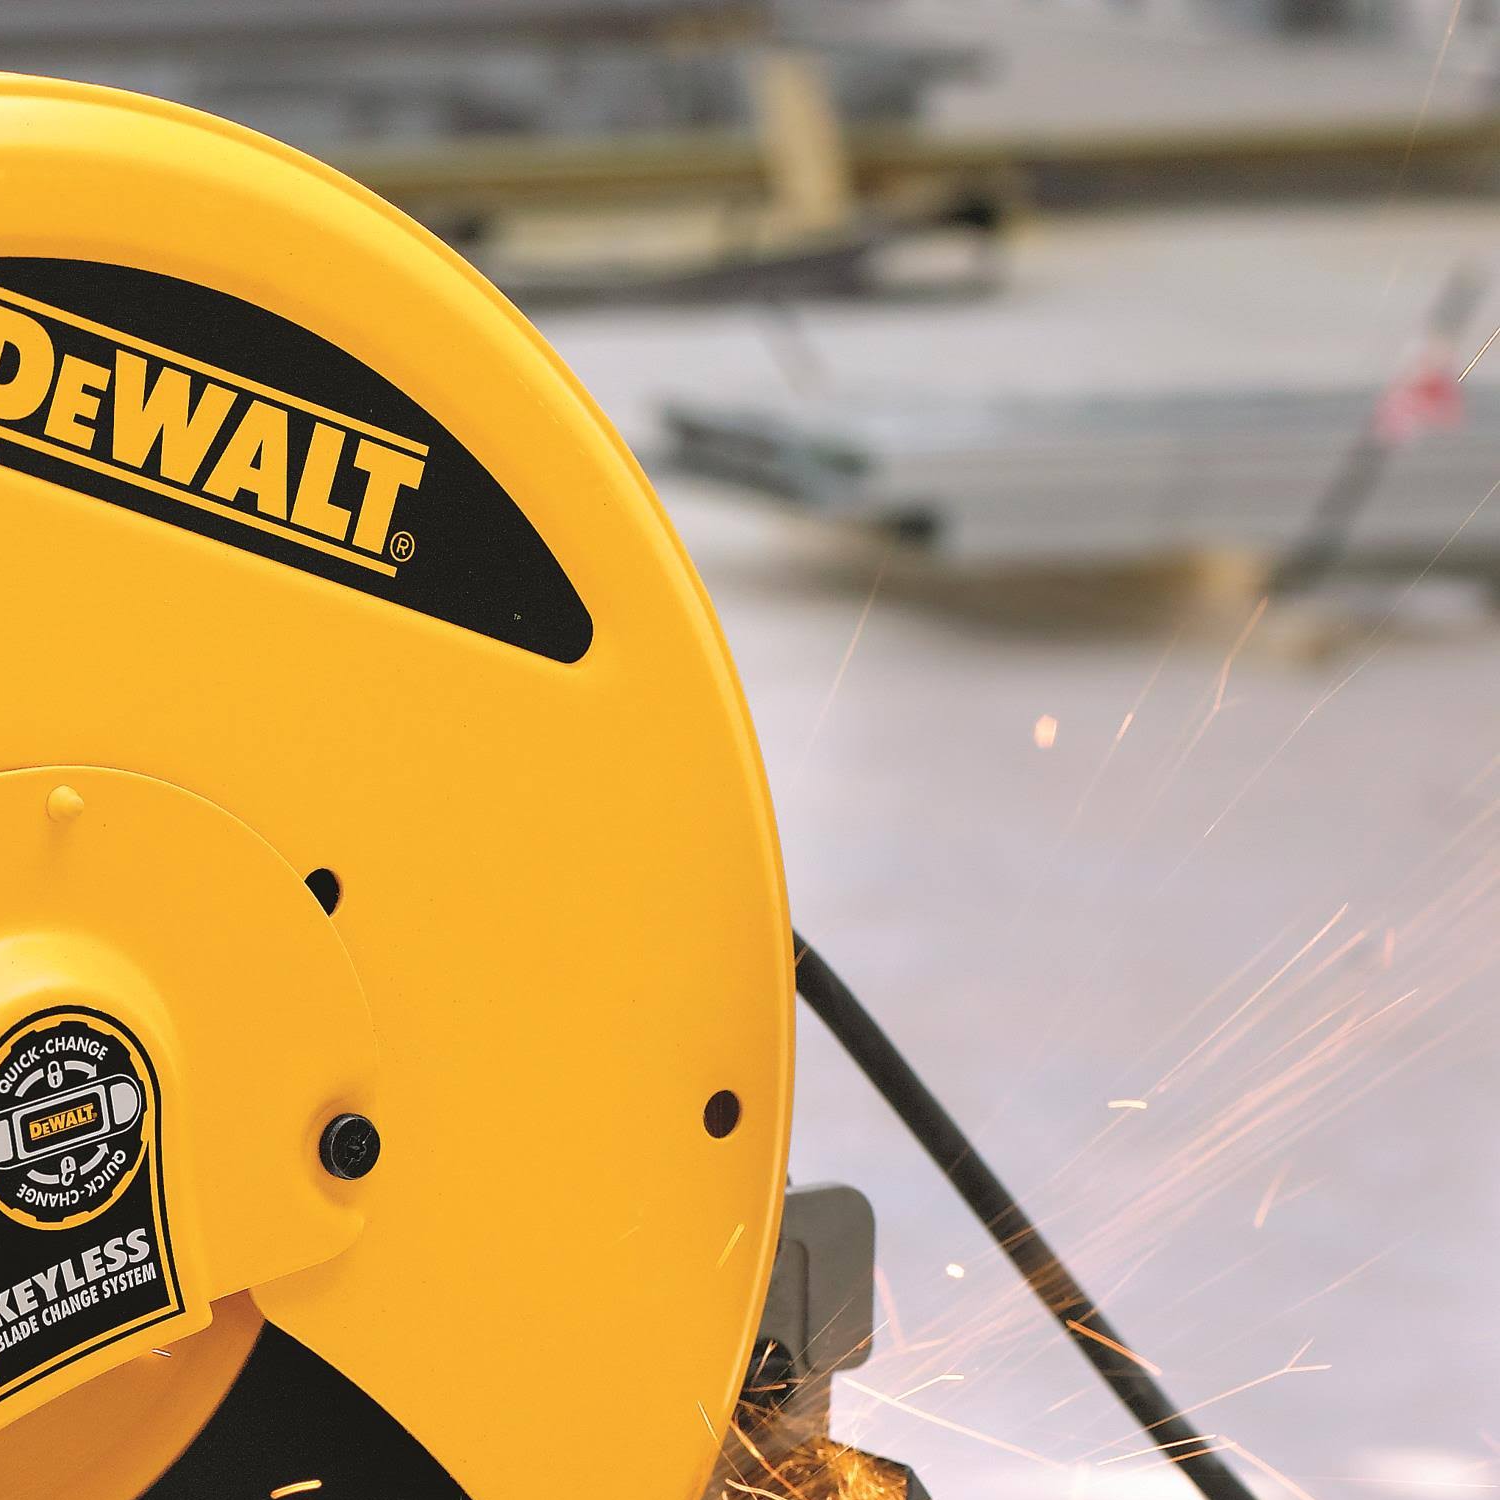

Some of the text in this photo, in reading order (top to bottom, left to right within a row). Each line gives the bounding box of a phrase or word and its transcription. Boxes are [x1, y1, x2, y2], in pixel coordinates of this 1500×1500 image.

[16, 1149, 127, 1207] QUICK-CHANGE
[41, 1285, 100, 1327] CHANGE
[101, 1262, 157, 1299] SYSTEM
